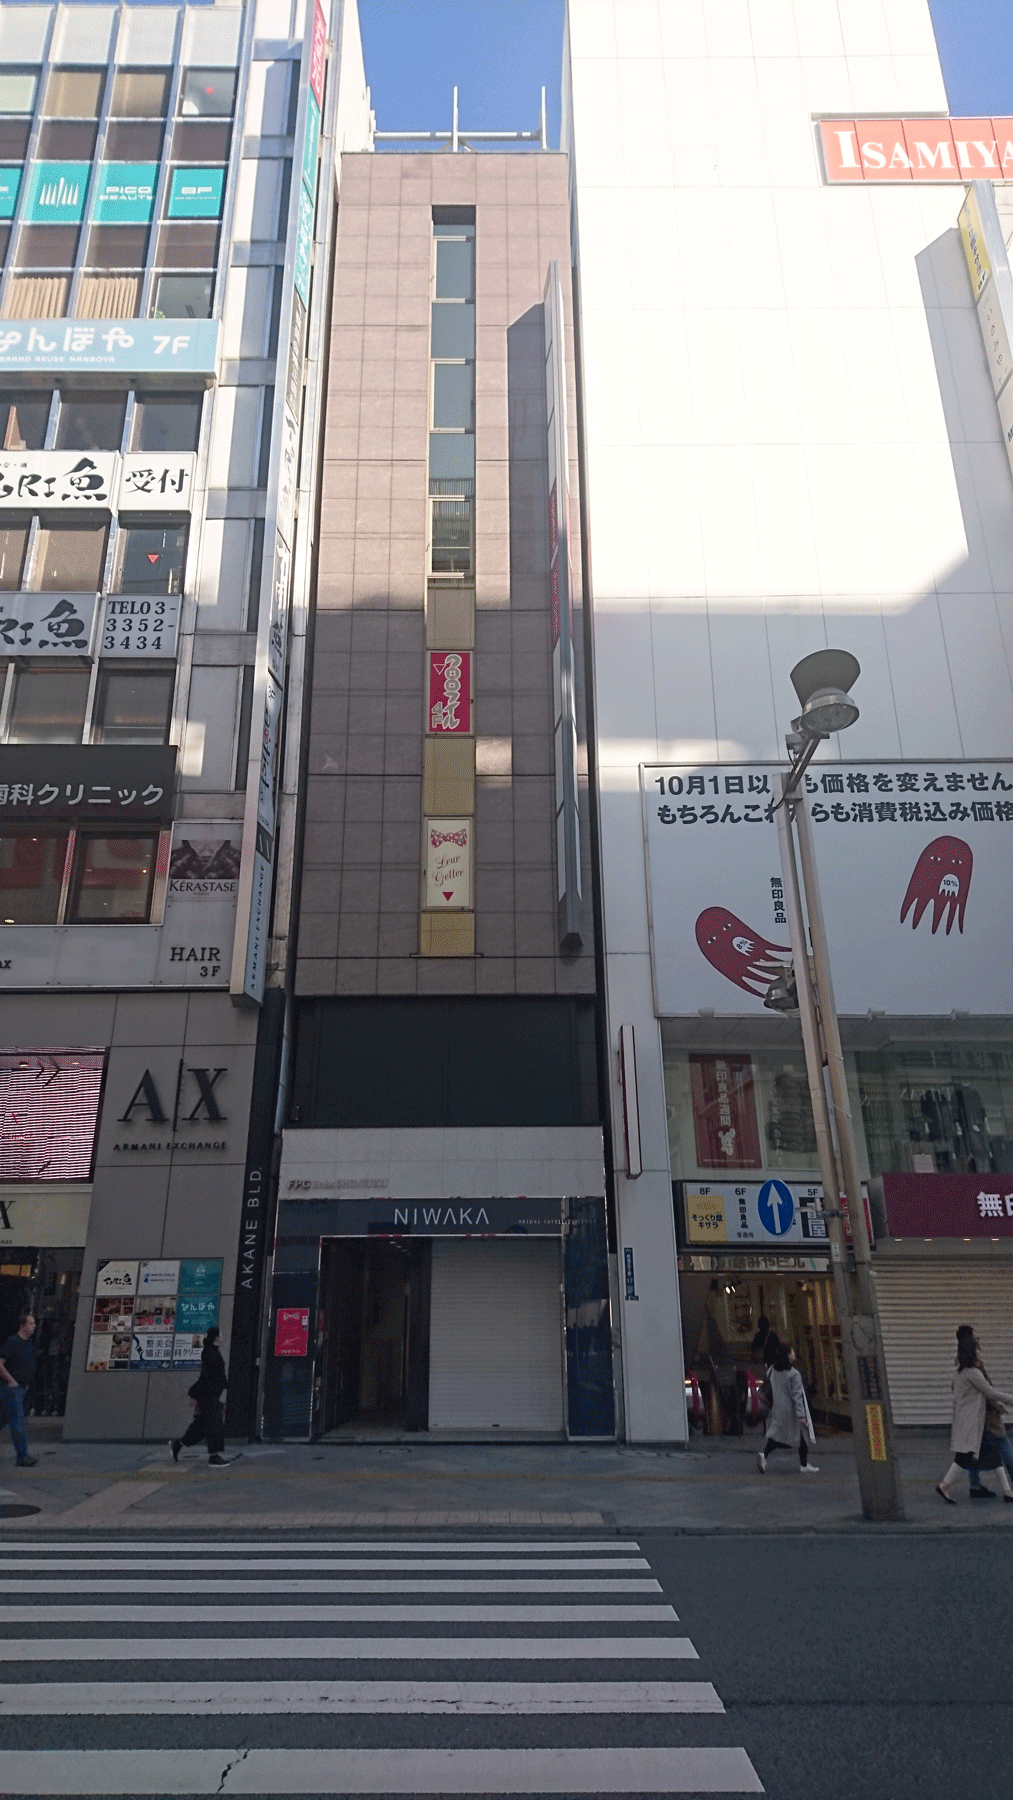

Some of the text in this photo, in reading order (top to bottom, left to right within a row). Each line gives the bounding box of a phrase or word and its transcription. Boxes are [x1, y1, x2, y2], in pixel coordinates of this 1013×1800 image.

[106, 186, 151, 195] PICO
[153, 335, 191, 354] 7F
[125, 468, 189, 494] 受付
[106, 618, 175, 632] 3352-
[104, 635, 162, 650] 3434
[655, 772, 1013, 796] 10月1日以も価格を変えません
[657, 800, 1013, 825] もちろんこれらも消費税込み価格
[169, 880, 236, 892] KÉRASTASE
[942, 878, 959, 887] 10%
[770, 877, 787, 924] 無印良品
[250, 866, 266, 991] ARMANI EXCHANGE
[735, 937, 749, 950] 8%
[169, 947, 221, 961] HAIR
[113, 1141, 228, 1151] ARMANI EXCHANGE
[288, 1179, 311, 1190] FPG
[699, 1187, 711, 1195] 8F
[734, 1188, 747, 1196] 6F
[738, 1198, 749, 1229] 無印良品
[241, 1167, 263, 1289] AKANE BLD.
